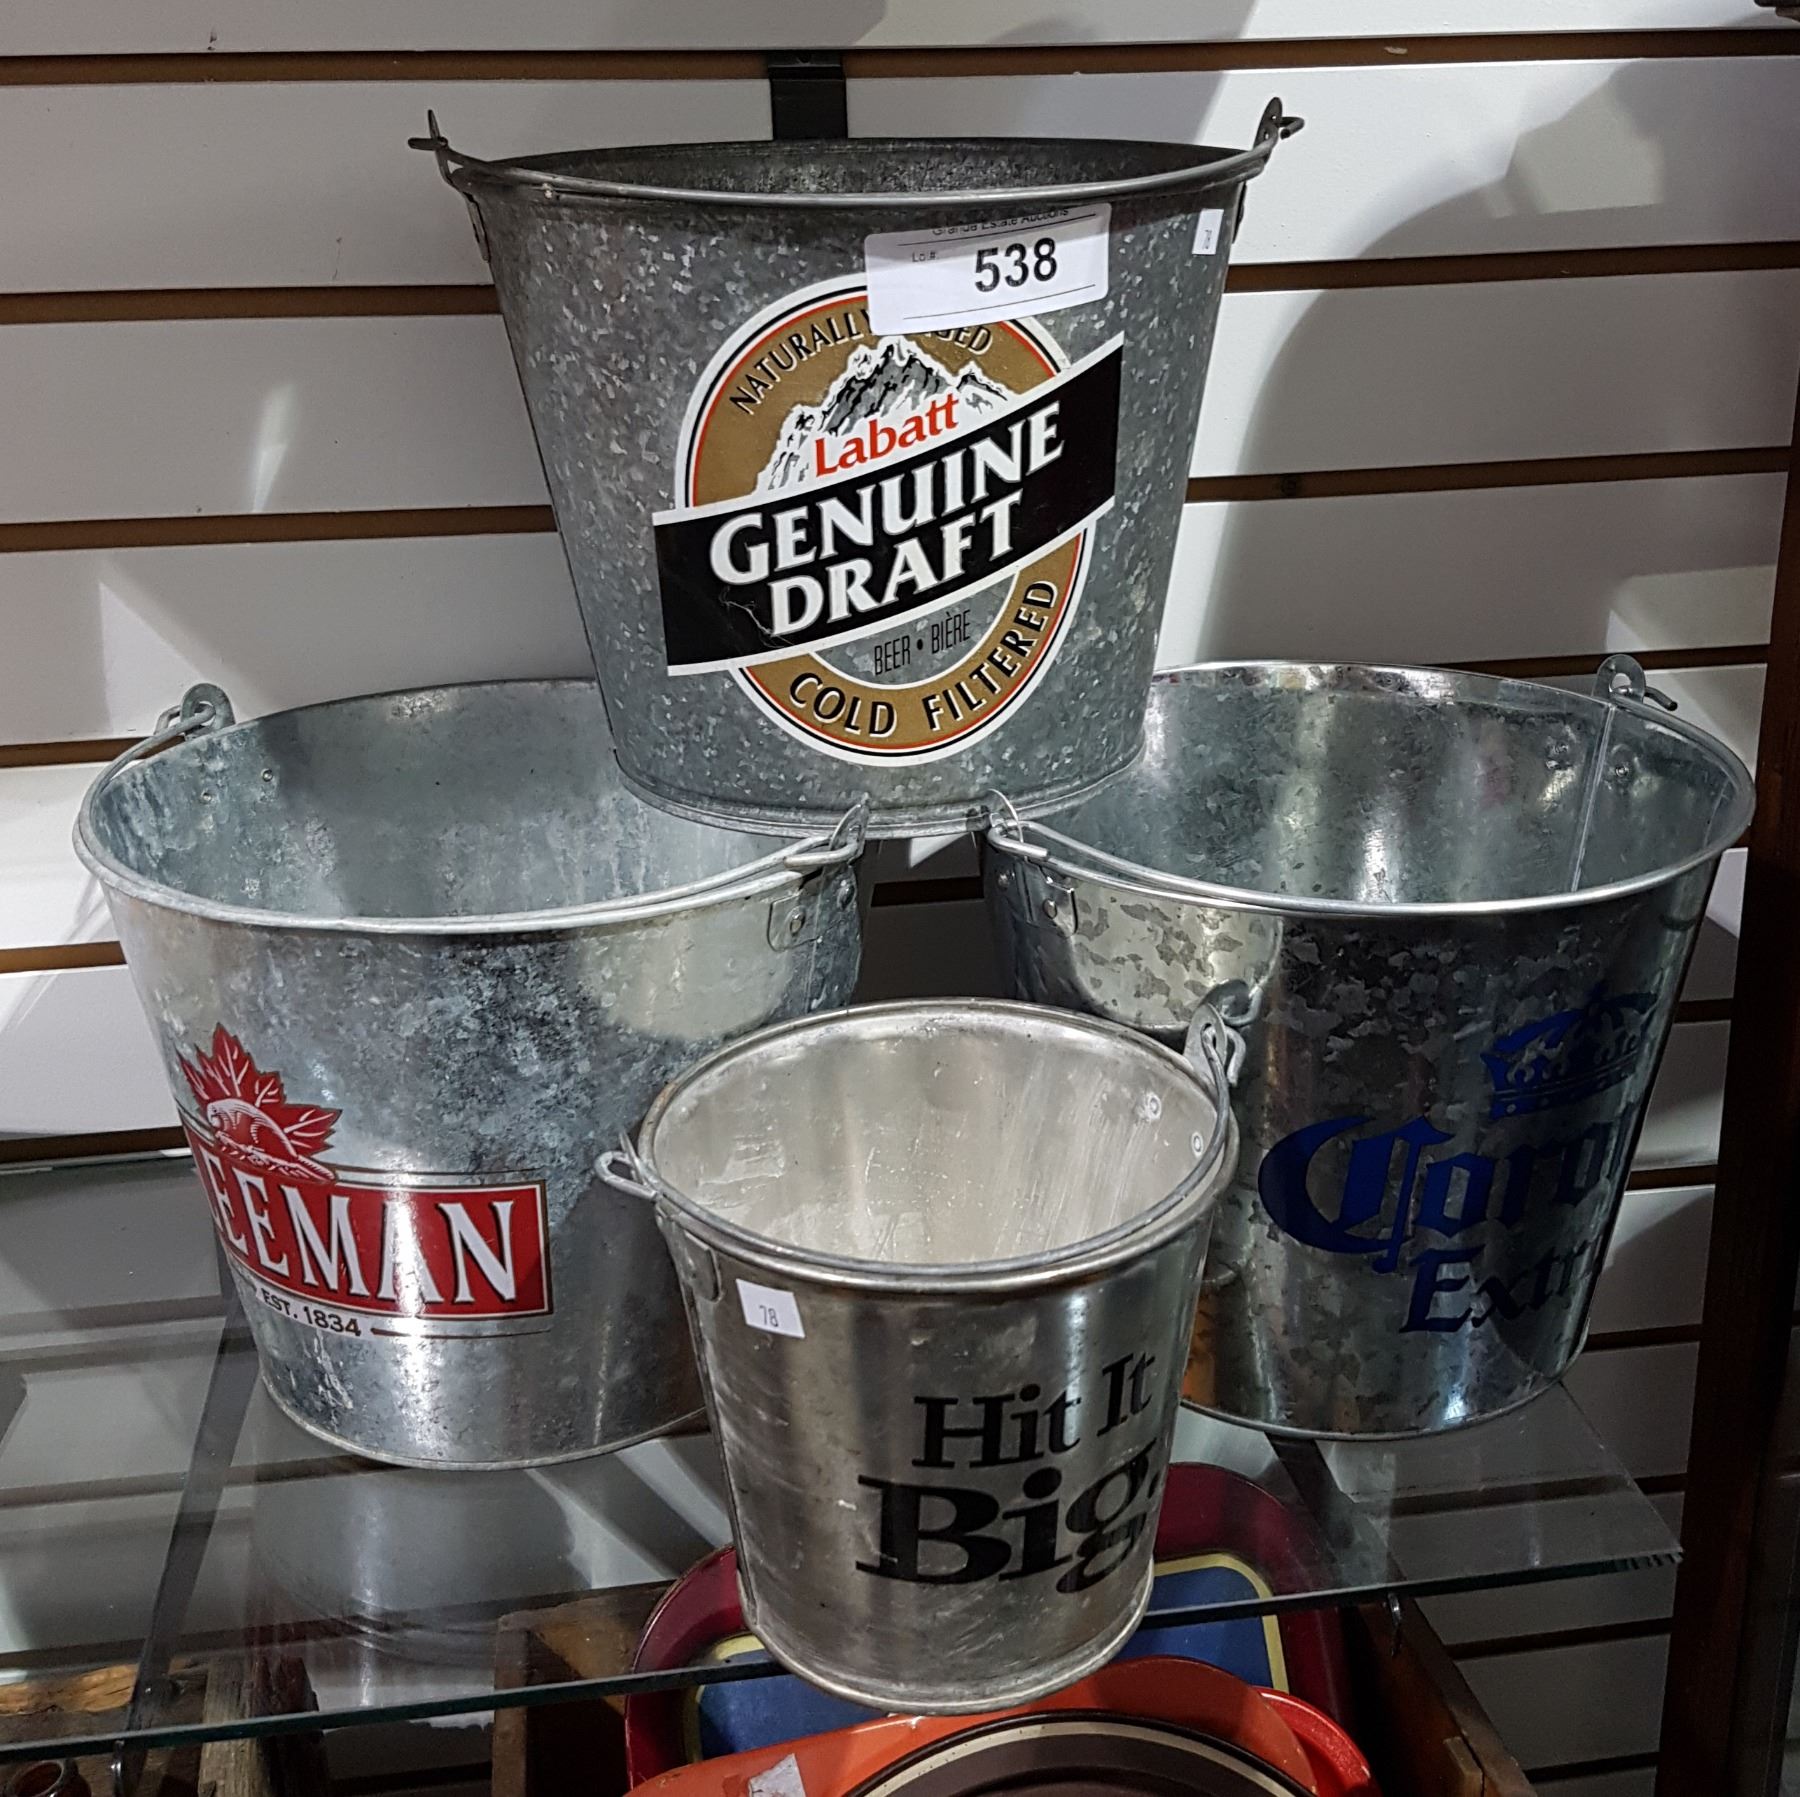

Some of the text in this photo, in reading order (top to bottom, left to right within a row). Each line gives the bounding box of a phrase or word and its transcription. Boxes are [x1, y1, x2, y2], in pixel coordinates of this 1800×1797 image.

[974, 237, 1058, 293] 538
[814, 392, 960, 478] Labatt
[709, 400, 1066, 586] GENUINE
[767, 489, 1024, 638] DRAFT
[789, 579, 1060, 738] COLD FILTERED
[873, 609, 972, 675] BEER BIÈRE
[261, 1287, 362, 1337] EST. 1834
[758, 1304, 779, 1328] 78
[911, 1351, 1156, 1470] Hit It
